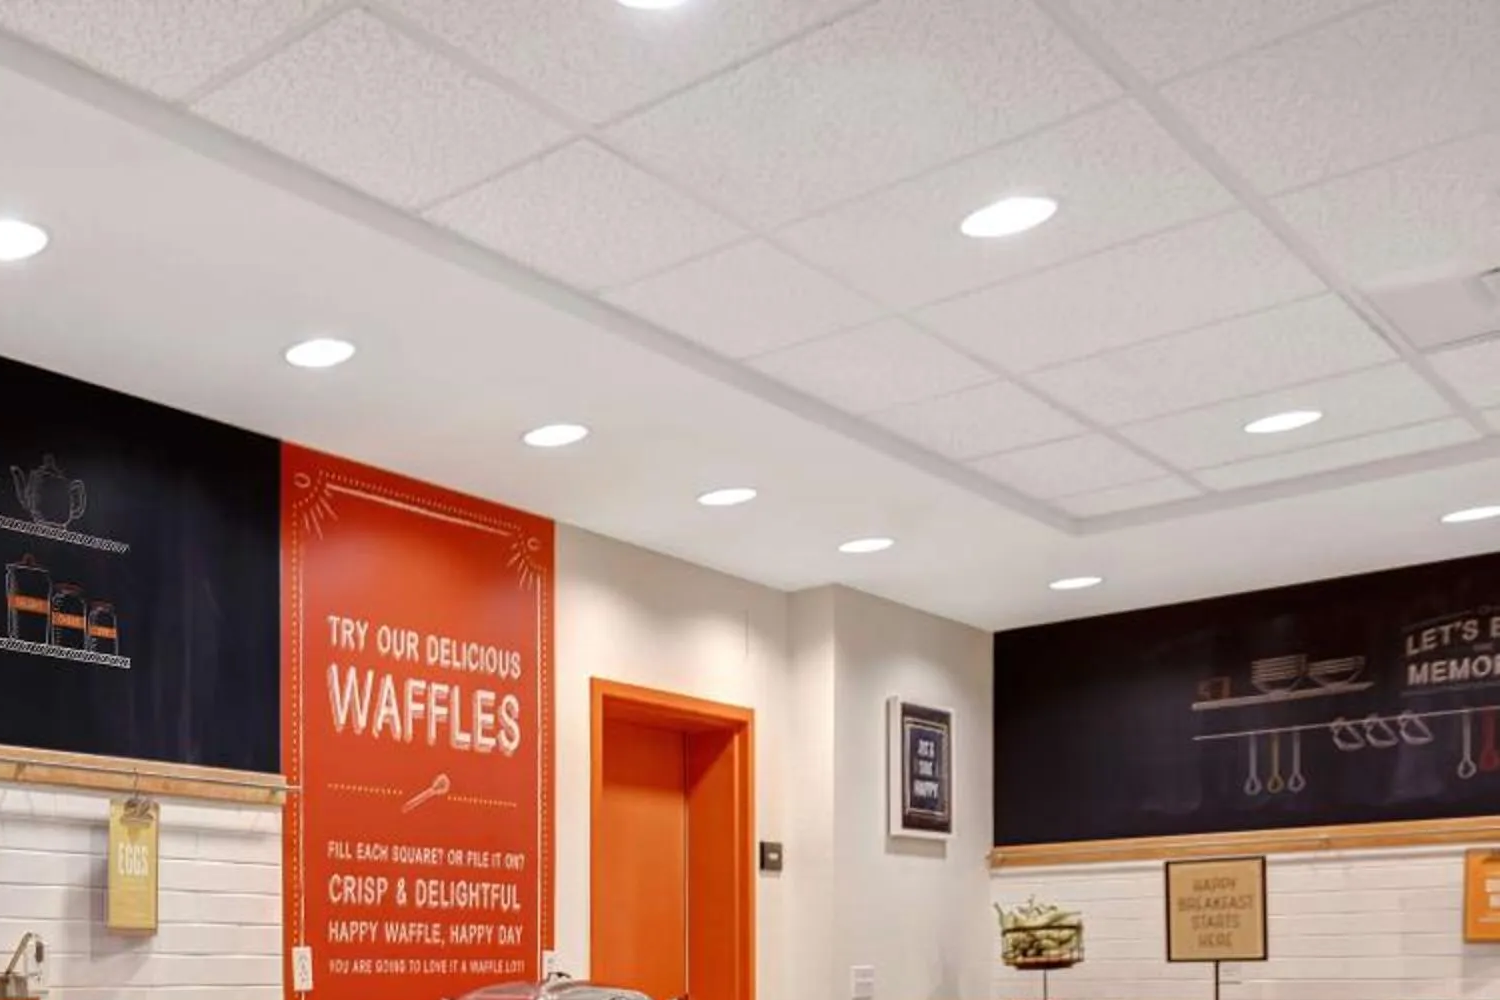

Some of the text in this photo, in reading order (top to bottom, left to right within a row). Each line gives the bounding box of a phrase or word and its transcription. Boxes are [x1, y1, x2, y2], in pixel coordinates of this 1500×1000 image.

[327, 615, 522, 680] TRY OUR DELICIOUS
[1406, 619, 1479, 657] LET'S
[327, 662, 521, 757] WAFFLES
[117, 842, 149, 876] EGGS
[327, 840, 352, 859] FILL
[356, 842, 389, 861] EACH
[447, 850, 463, 867] OR
[491, 853, 501, 869] IT
[328, 874, 521, 912] CRISP & DELIGHTFUL
[328, 920, 524, 948] HAPPY WAFFLE, HAPPY DAY
[329, 959, 348, 975] YOU
[351, 959, 373, 974] ARE
[375, 959, 405, 974] GOING
[408, 959, 421, 974] TO
[423, 959, 450, 974] LOVE
[469, 959, 502, 974] WAFFLE
